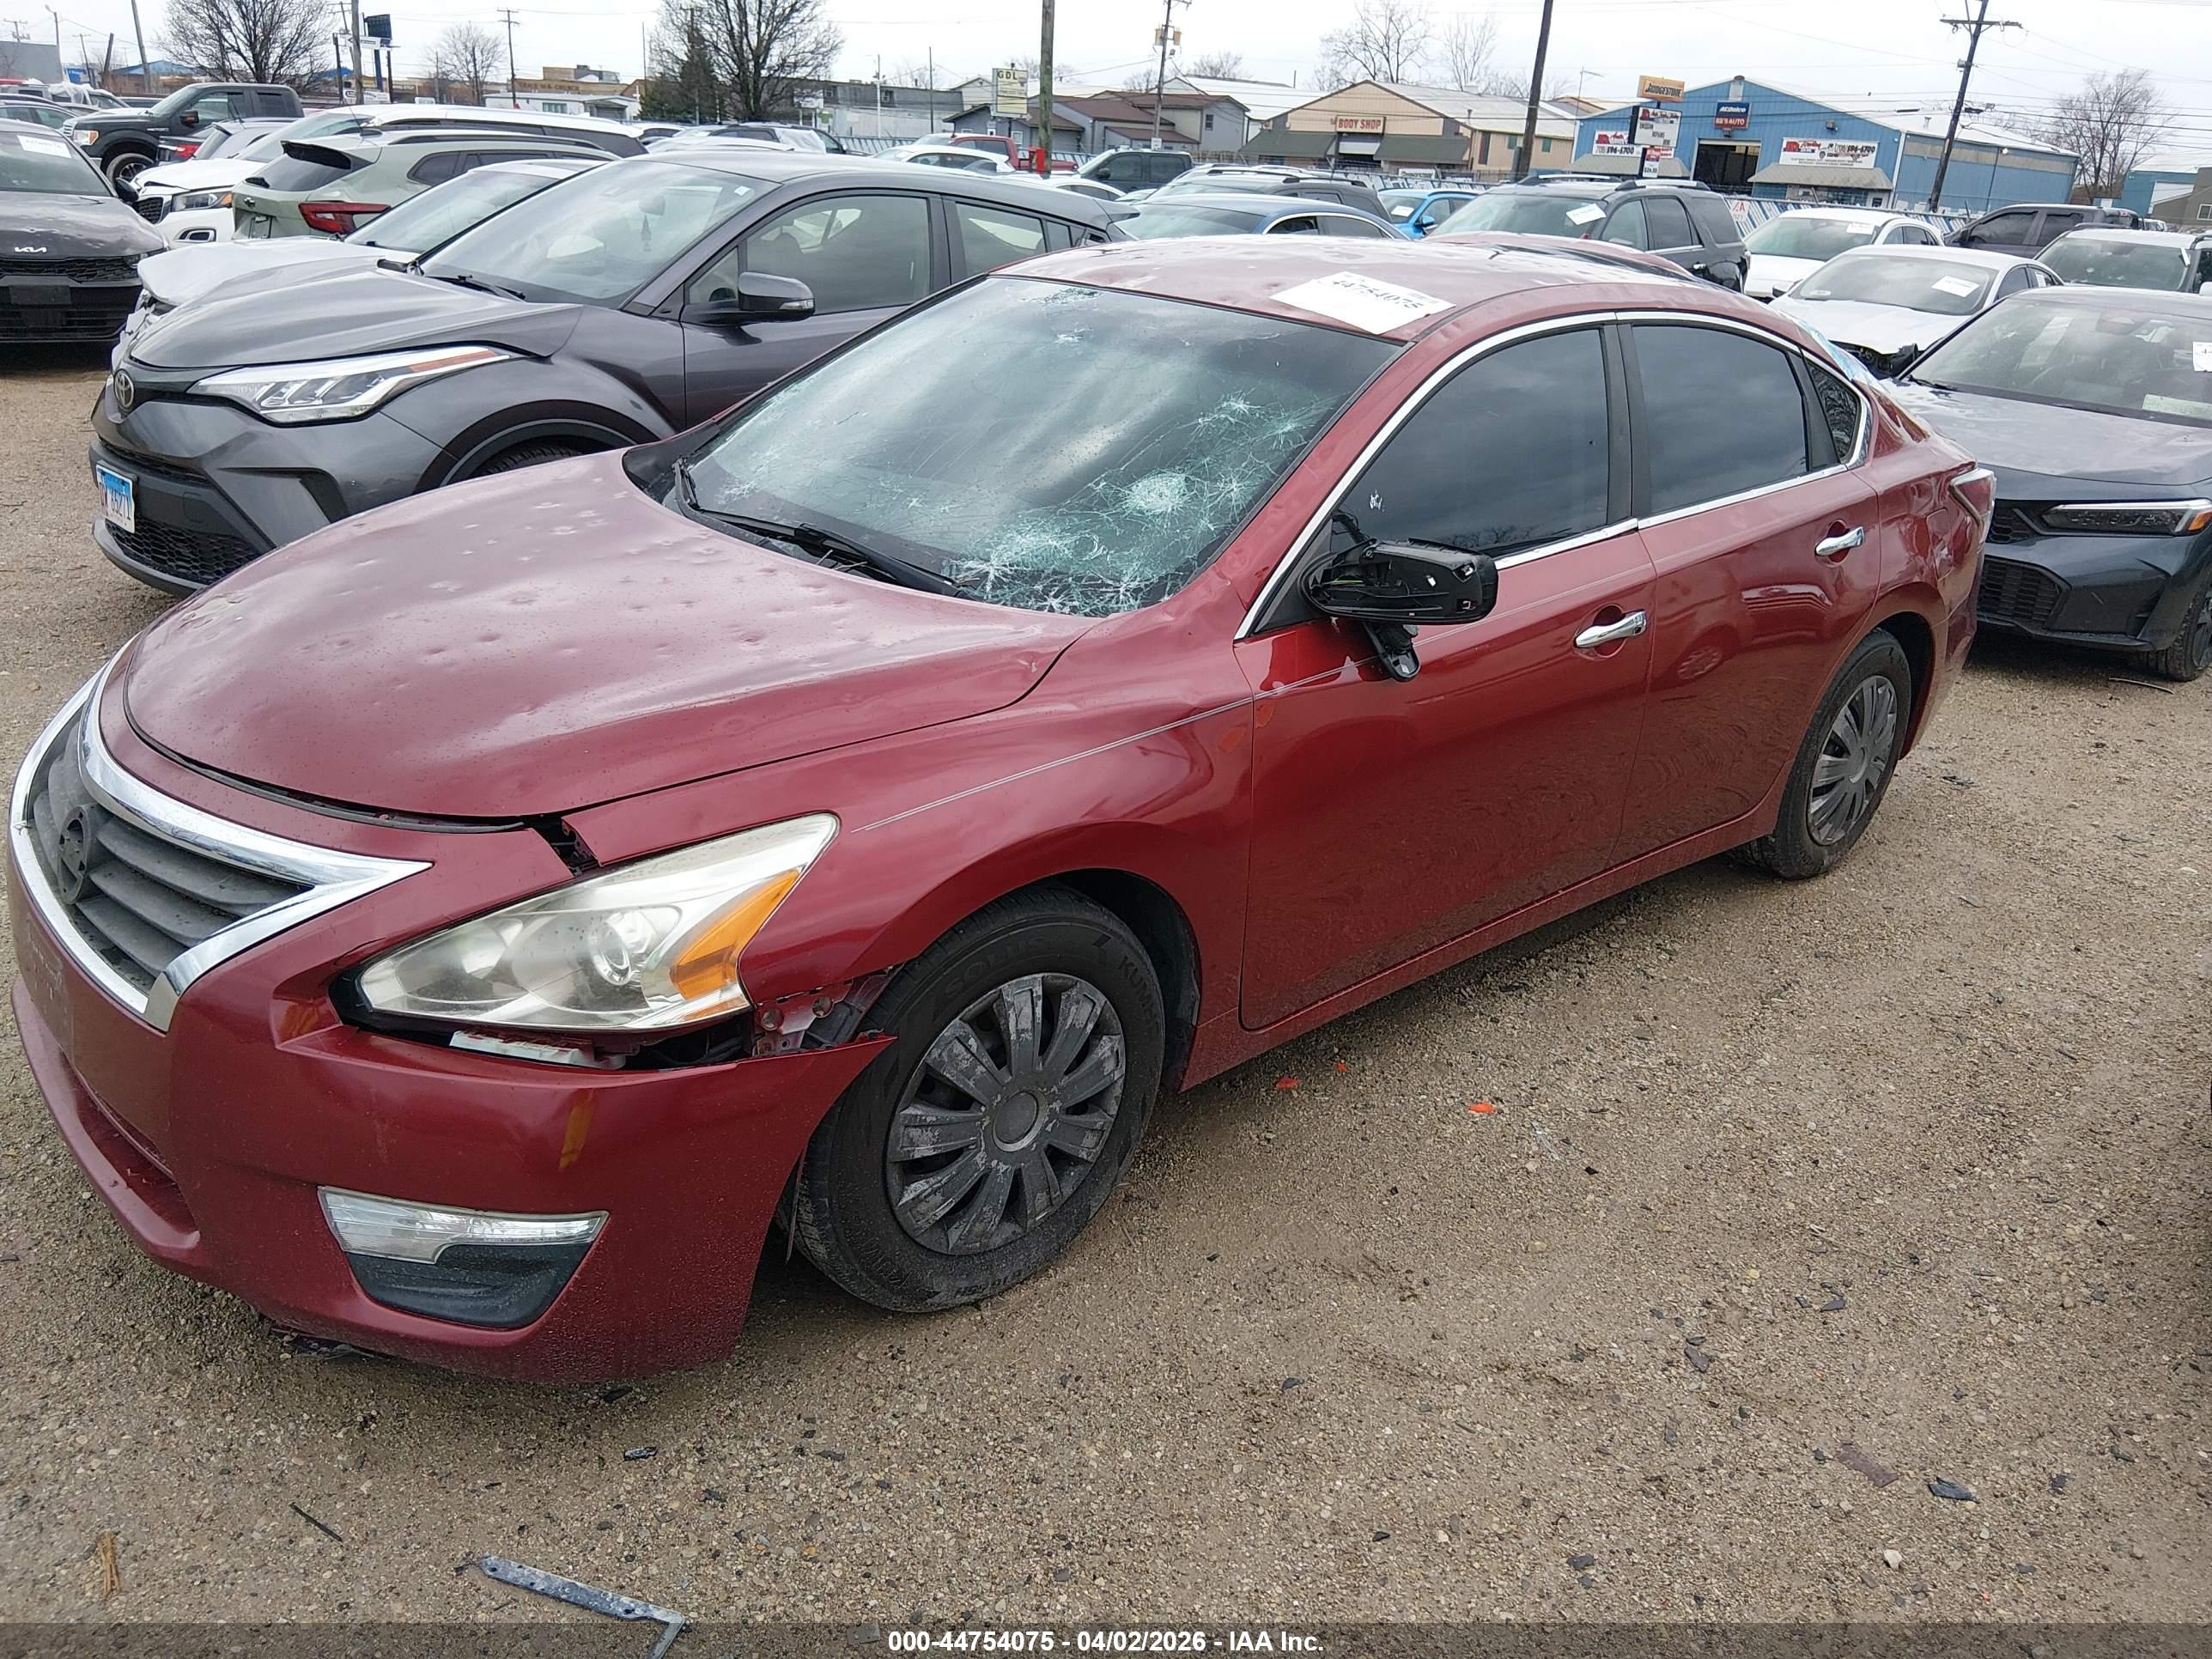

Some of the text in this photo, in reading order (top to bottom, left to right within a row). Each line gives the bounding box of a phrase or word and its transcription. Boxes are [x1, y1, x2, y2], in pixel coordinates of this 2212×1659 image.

[997, 70, 1018, 80] GDL
[1338, 118, 1382, 130] BODY SHOP
[1607, 146, 1635, 155] 596-5700
[111, 488, 131, 520] 65271
